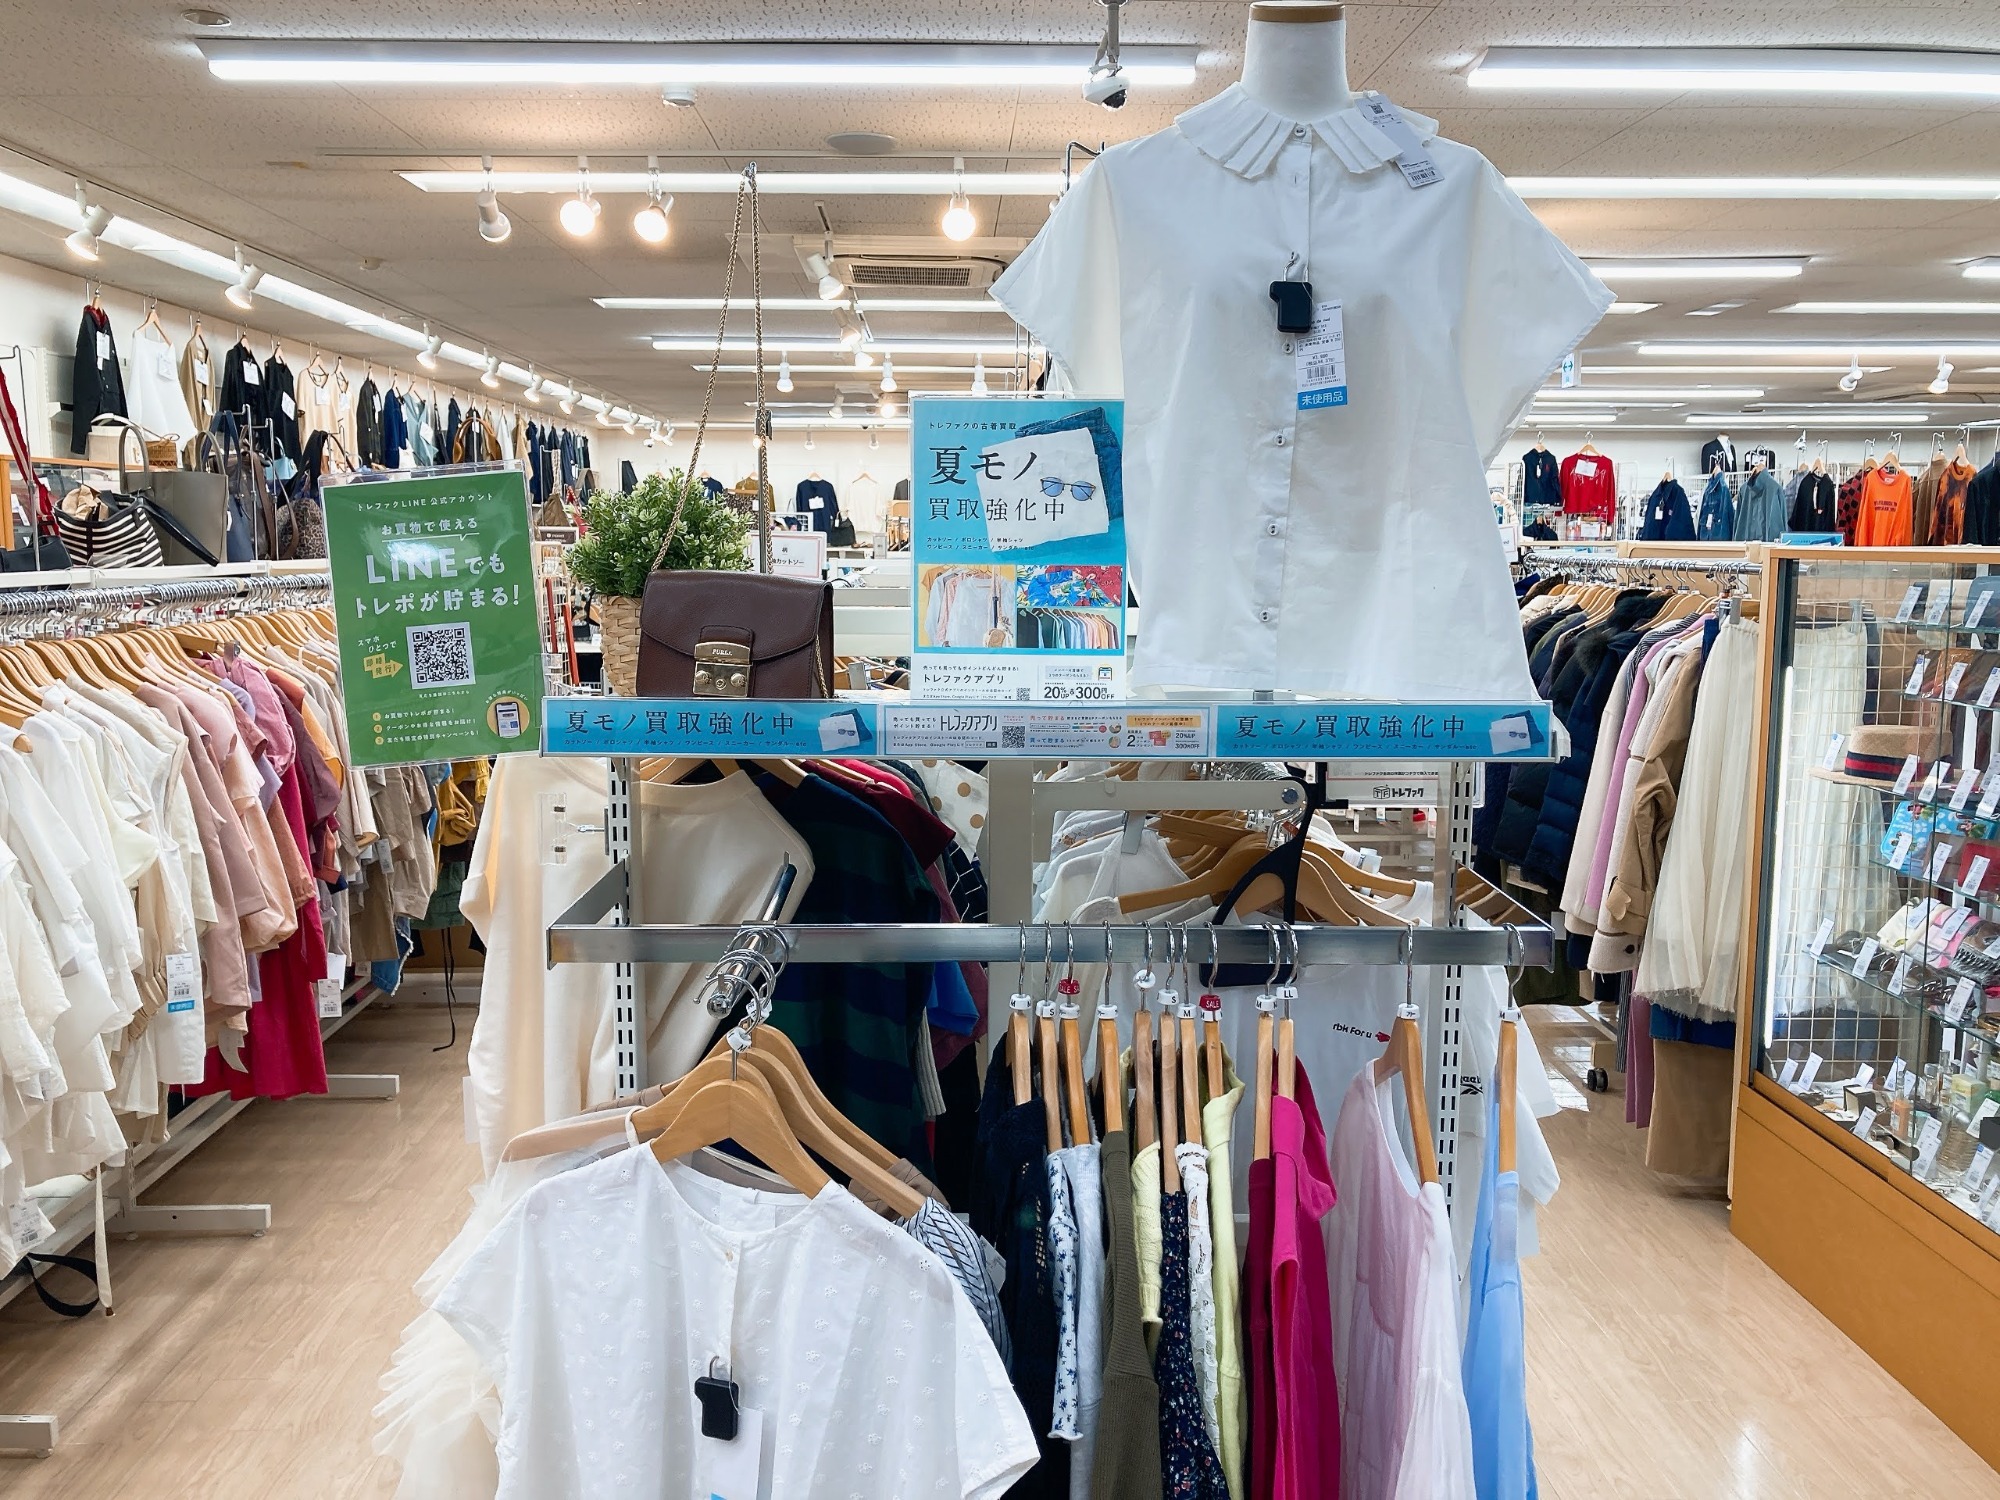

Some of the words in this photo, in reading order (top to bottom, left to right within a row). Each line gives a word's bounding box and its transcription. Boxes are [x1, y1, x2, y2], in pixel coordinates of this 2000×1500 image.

[1301, 391, 1344, 406] 未使用品
[929, 422, 1017, 430] トレファクの古着買取
[928, 446, 1038, 485] 夏モノ
[358, 499, 426, 512] トレファクLINE
[431, 493, 493, 505] 公式アカウント
[928, 498, 1065, 522] 買取強化中
[382, 518, 478, 536] お買物で使える
[366, 548, 505, 584] LINEでも
[356, 584, 519, 618] トレポが貯まる!
[358, 636, 380, 646] スマホ
[368, 640, 396, 653] ひとつで
[925, 674, 1004, 684] トレファクアプリ
[564, 710, 794, 736] 夏モノ買取強化中
[940, 715, 997, 731] トレファクアプリ
[1234, 714, 1464, 738] 夏モノ買取強化中
[1127, 735, 1136, 747] 2
[1392, 788, 1424, 798] トレファク
[1284, 990, 1293, 998] LL
